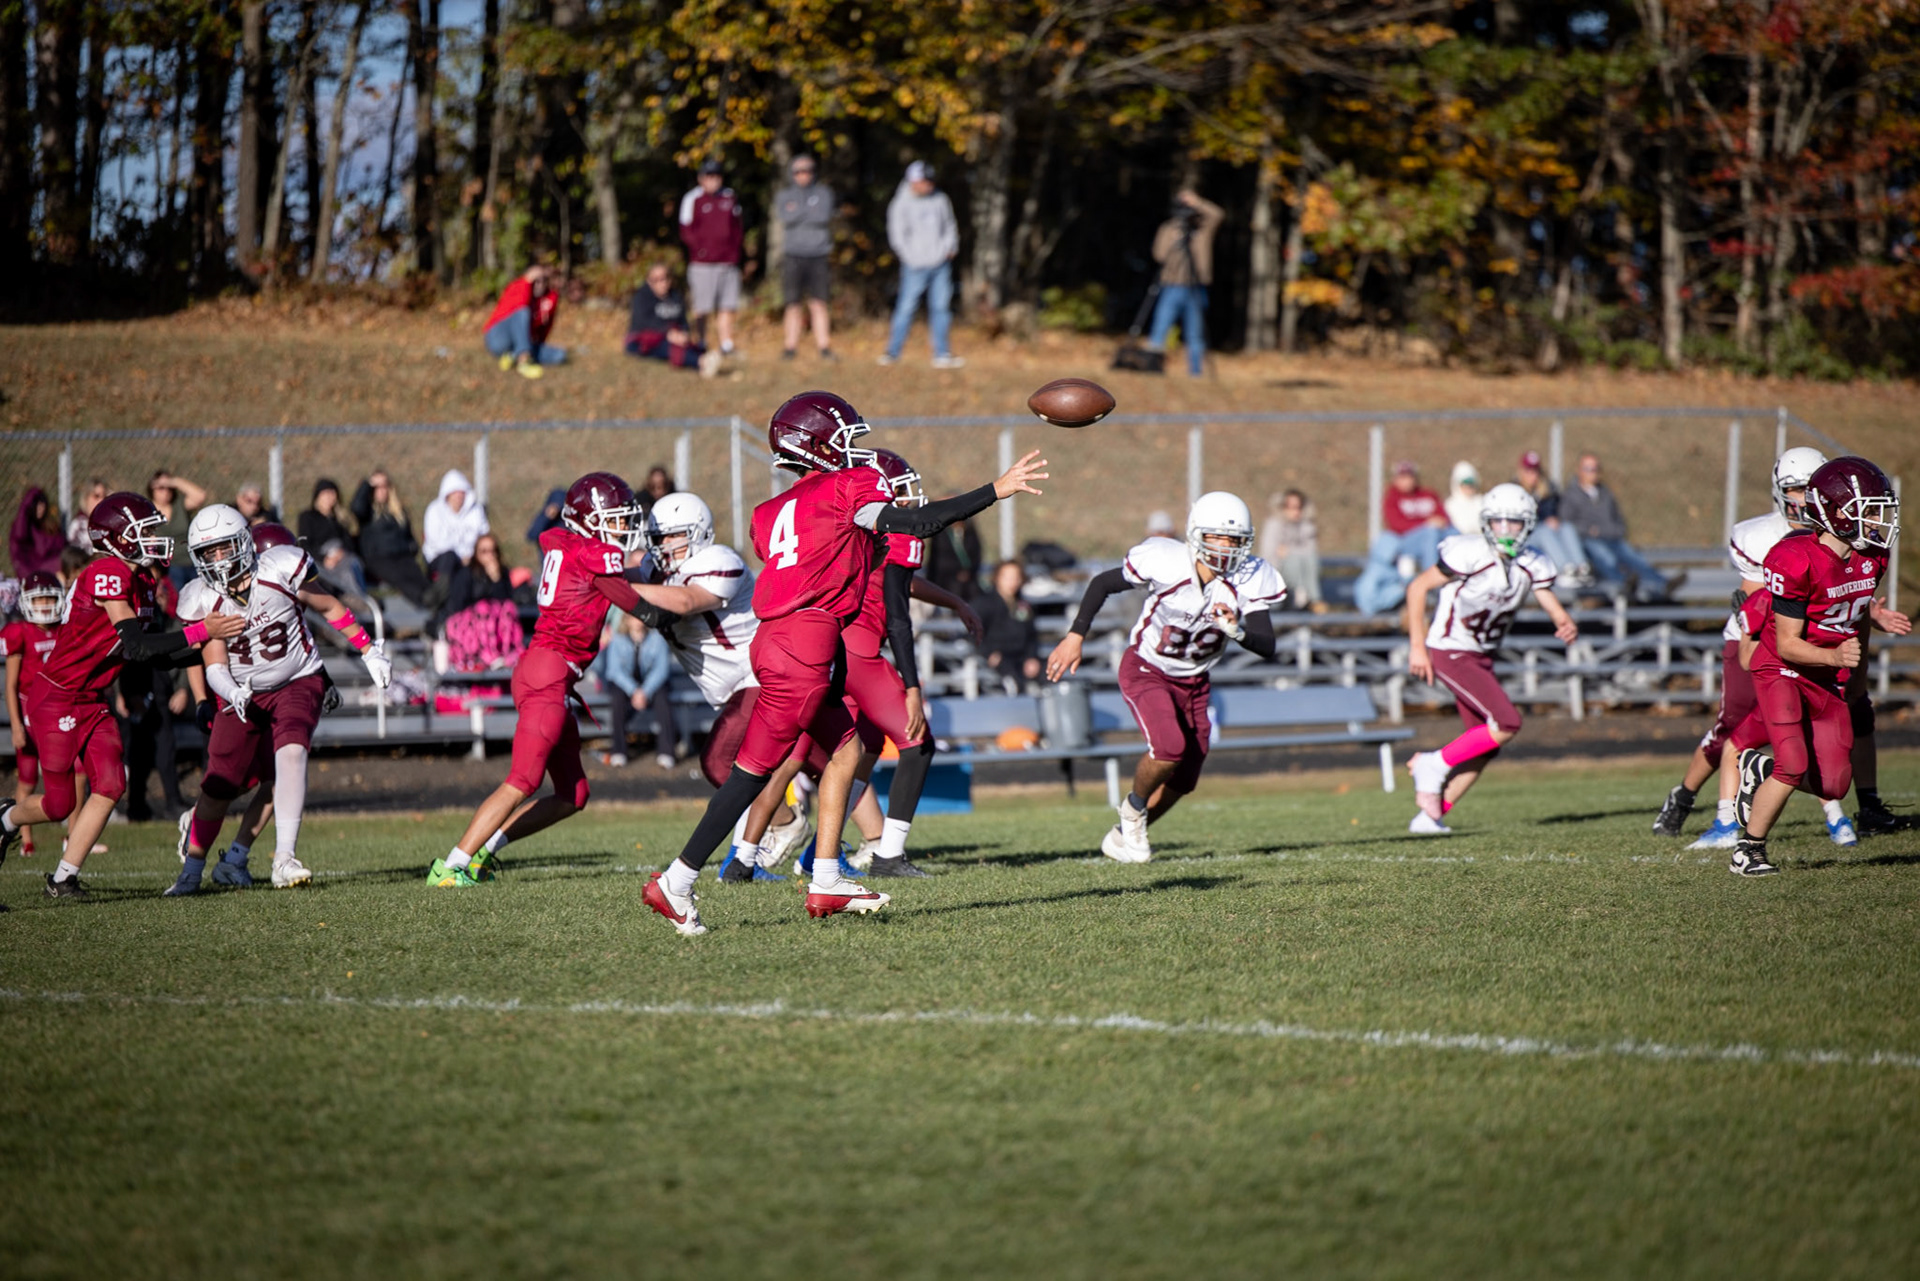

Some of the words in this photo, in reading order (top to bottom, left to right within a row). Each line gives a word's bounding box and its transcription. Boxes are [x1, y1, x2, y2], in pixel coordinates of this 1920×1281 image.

[876, 476, 893, 498] 4
[768, 498, 799, 570] 4
[907, 540, 924, 564] 11
[94, 574, 122, 596] 23
[1764, 567, 1785, 596] 26
[1826, 577, 1876, 599] WOLVERINES
[246, 611, 271, 630] AMS
